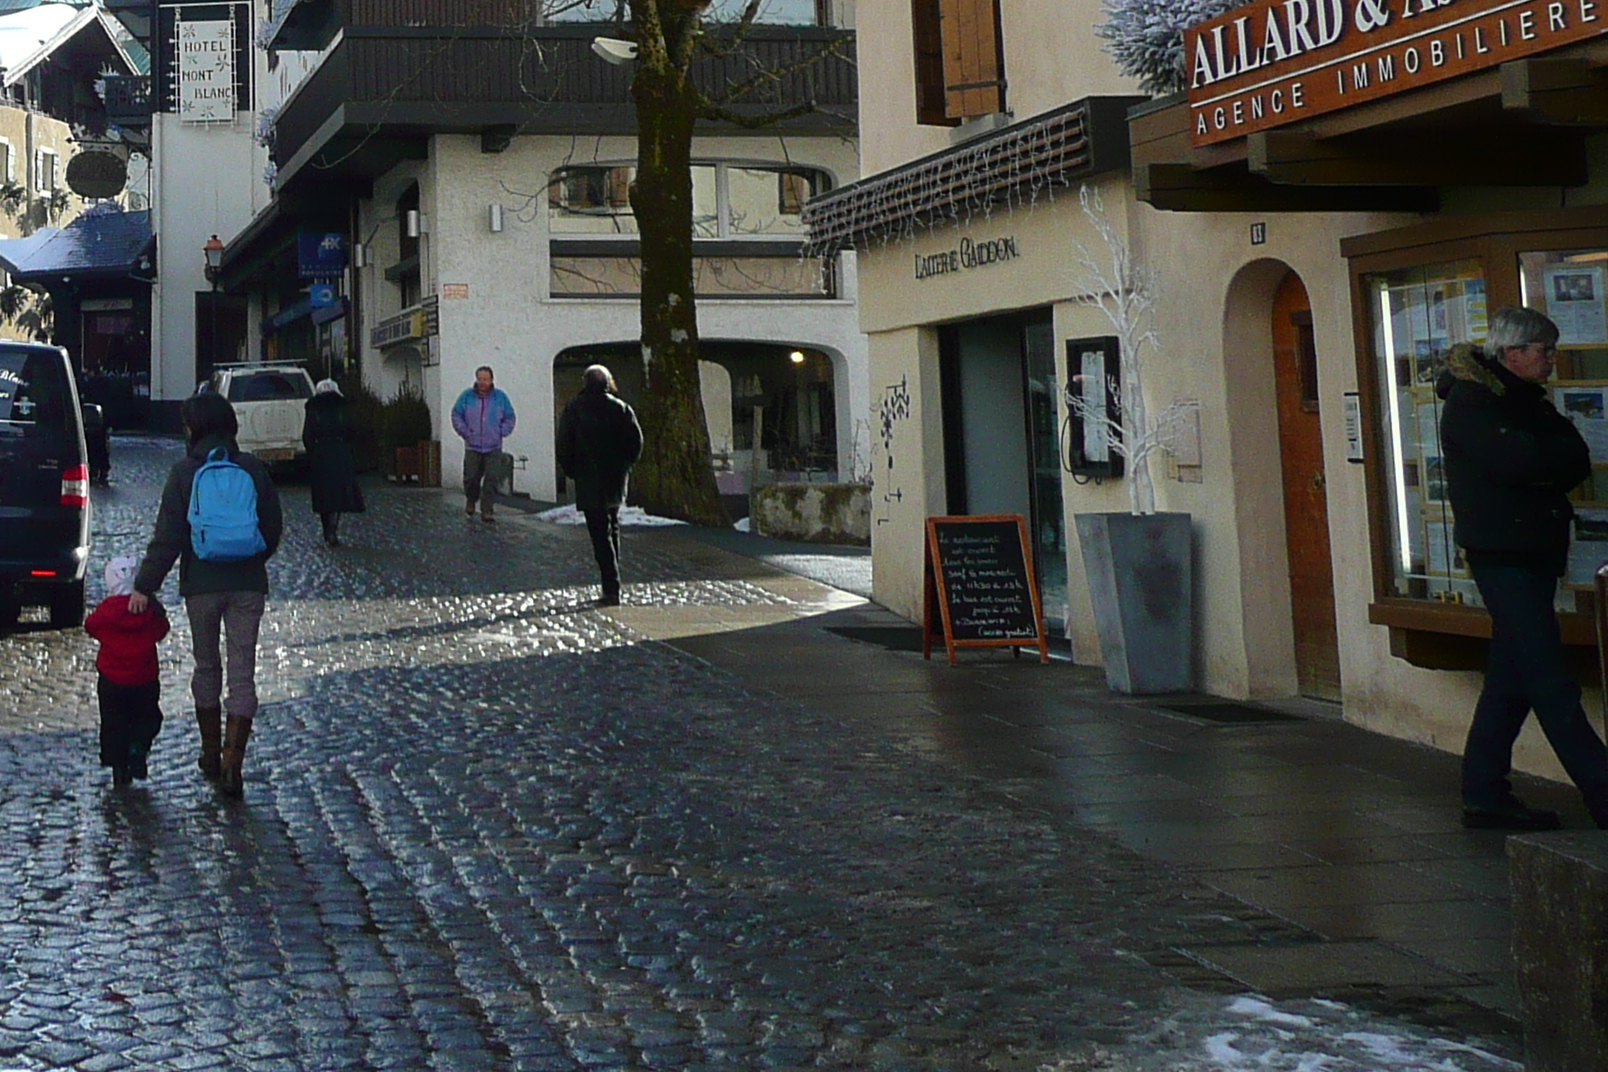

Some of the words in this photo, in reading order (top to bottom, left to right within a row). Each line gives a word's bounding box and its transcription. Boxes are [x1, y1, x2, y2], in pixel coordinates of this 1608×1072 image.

[184, 40, 227, 53] HOTEL
[182, 69, 214, 82] MONT
[194, 87, 231, 99] BLANC
[1196, 82, 1305, 136] AGENCE
